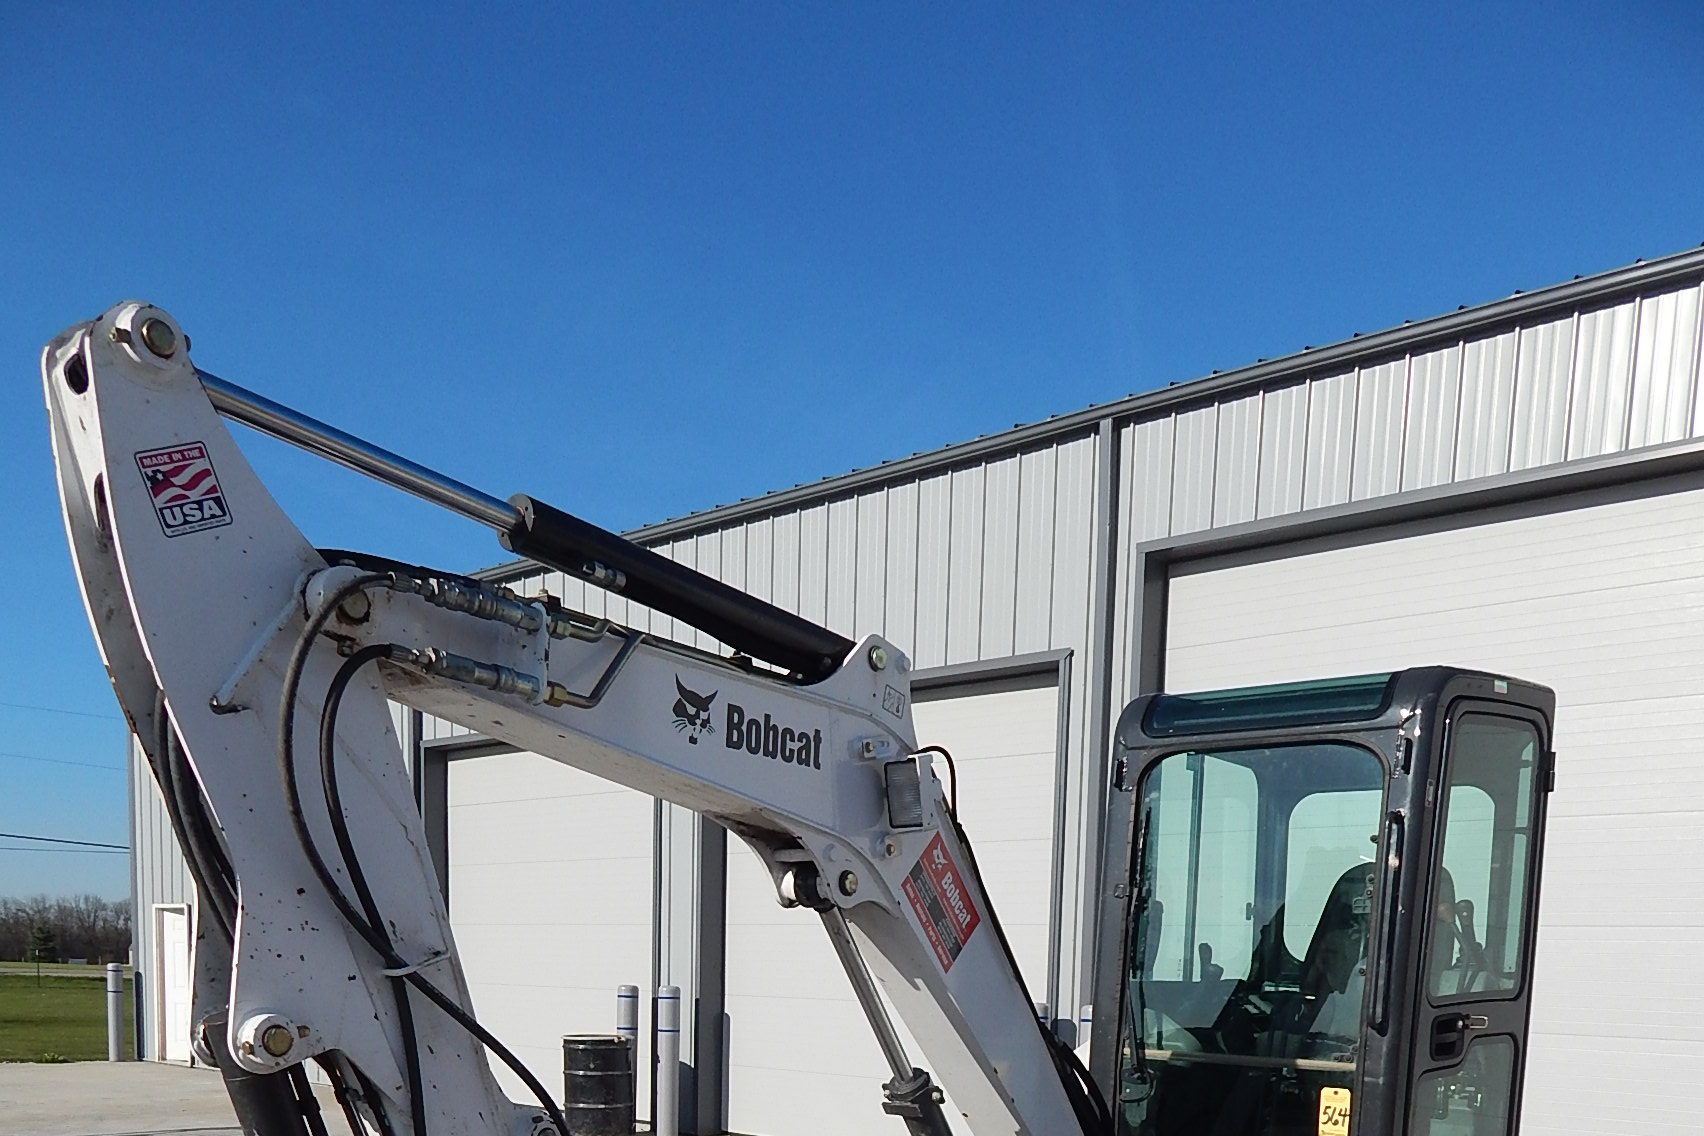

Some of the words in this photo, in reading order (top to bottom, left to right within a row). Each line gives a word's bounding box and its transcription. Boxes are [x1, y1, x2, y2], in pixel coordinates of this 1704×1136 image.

[142, 454, 170, 467] MADE
[172, 451, 183, 461] IN
[184, 448, 202, 459] THE
[162, 499, 224, 528] USA
[725, 702, 822, 771] Bobcat
[941, 871, 972, 929] Bobcat
[1321, 1105, 1351, 1128] 564
